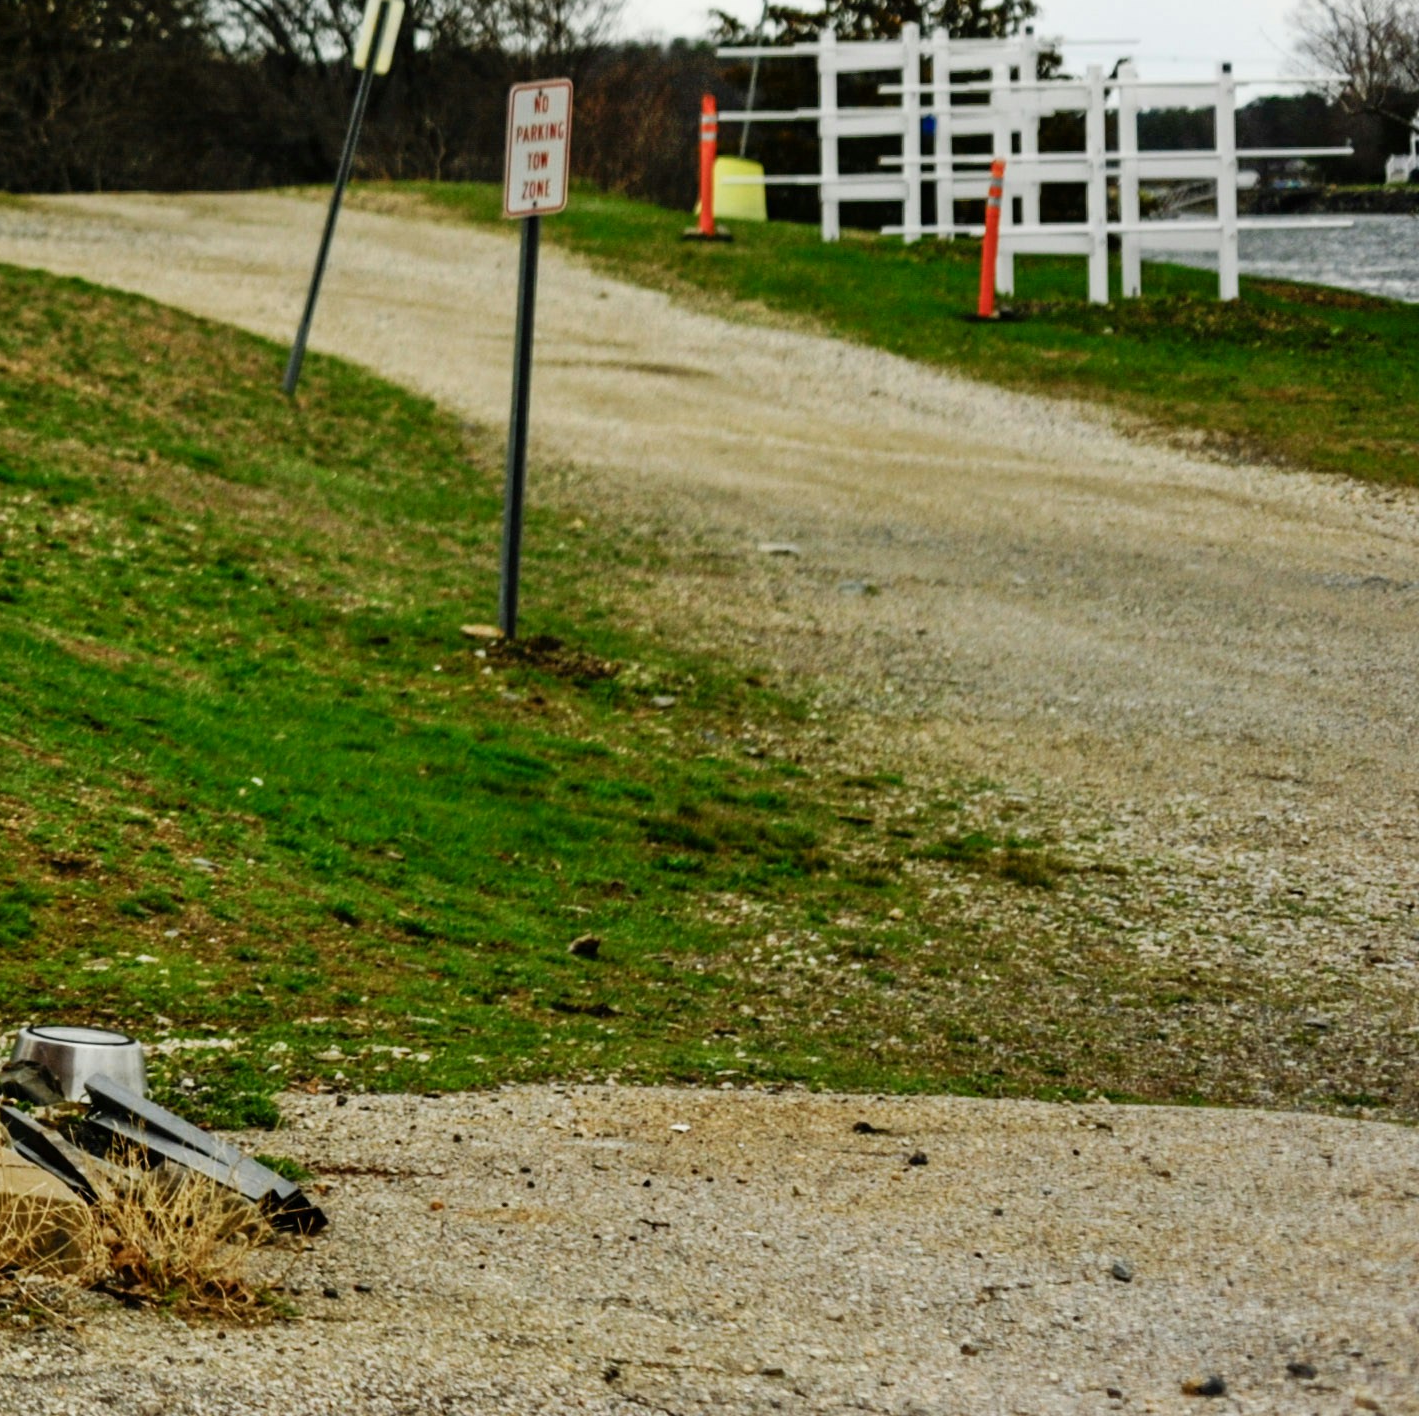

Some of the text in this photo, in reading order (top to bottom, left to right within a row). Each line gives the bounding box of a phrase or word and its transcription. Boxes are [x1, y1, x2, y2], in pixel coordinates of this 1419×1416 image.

[533, 95, 549, 114] NO
[516, 122, 564, 144] PARKING
[527, 151, 549, 171] TOW
[521, 178, 550, 200] ZONE
